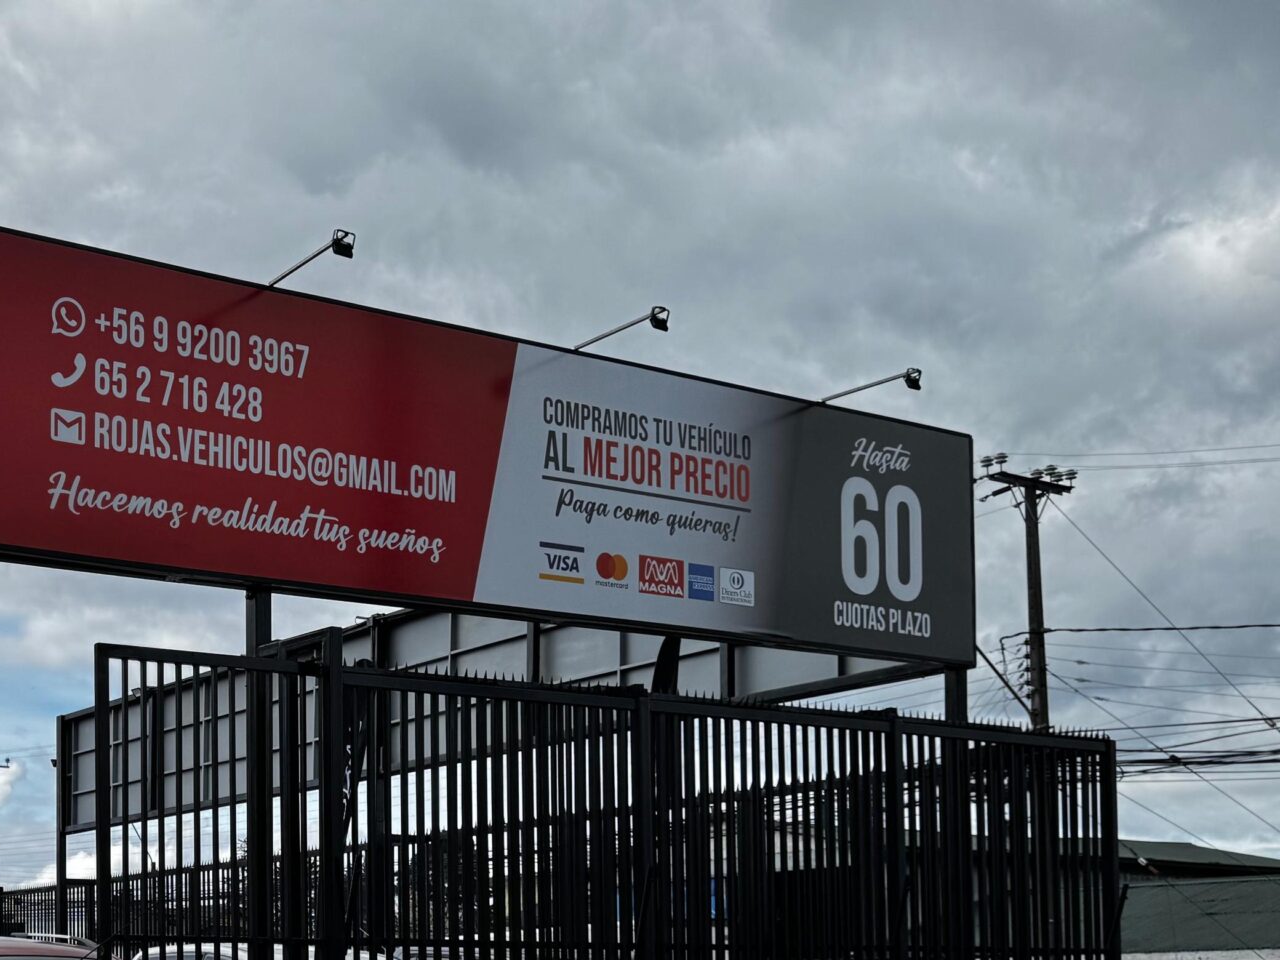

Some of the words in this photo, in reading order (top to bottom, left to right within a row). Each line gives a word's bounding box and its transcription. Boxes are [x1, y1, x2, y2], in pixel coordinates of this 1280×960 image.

[94, 307, 145, 348] +56
[152, 315, 169, 353] 9
[176, 320, 241, 367] 9200
[248, 335, 310, 380] 3967
[94, 357, 128, 399] 65
[135, 365, 152, 404] 2
[159, 370, 208, 413] 716
[214, 381, 264, 423] 428
[94, 411, 457, 503] ROJAS.VEHICULOS@GMAIL.COM
[543, 396, 649, 442] COMPRAMOS
[652, 417, 674, 447] TU
[677, 422, 752, 461] VEHÍCULO
[850, 437, 911, 474] Hasta
[543, 430, 575, 474] AL
[583, 436, 662, 489] MEJOR
[670, 451, 751, 503] PRECIO
[47, 470, 188, 529] Hacemos
[191, 496, 310, 540] realidad
[306, 505, 354, 552] tus
[356, 528, 447, 564] sueños
[555, 488, 610, 524] Paga
[613, 504, 663, 526] como
[666, 510, 741, 543] quieras!
[840, 476, 923, 602] 60
[544, 552, 580, 573] VISA
[595, 579, 629, 590] mastercard
[638, 582, 684, 596] MAGNA
[833, 600, 886, 632] CUOTAS
[889, 608, 931, 638] PLAZO
